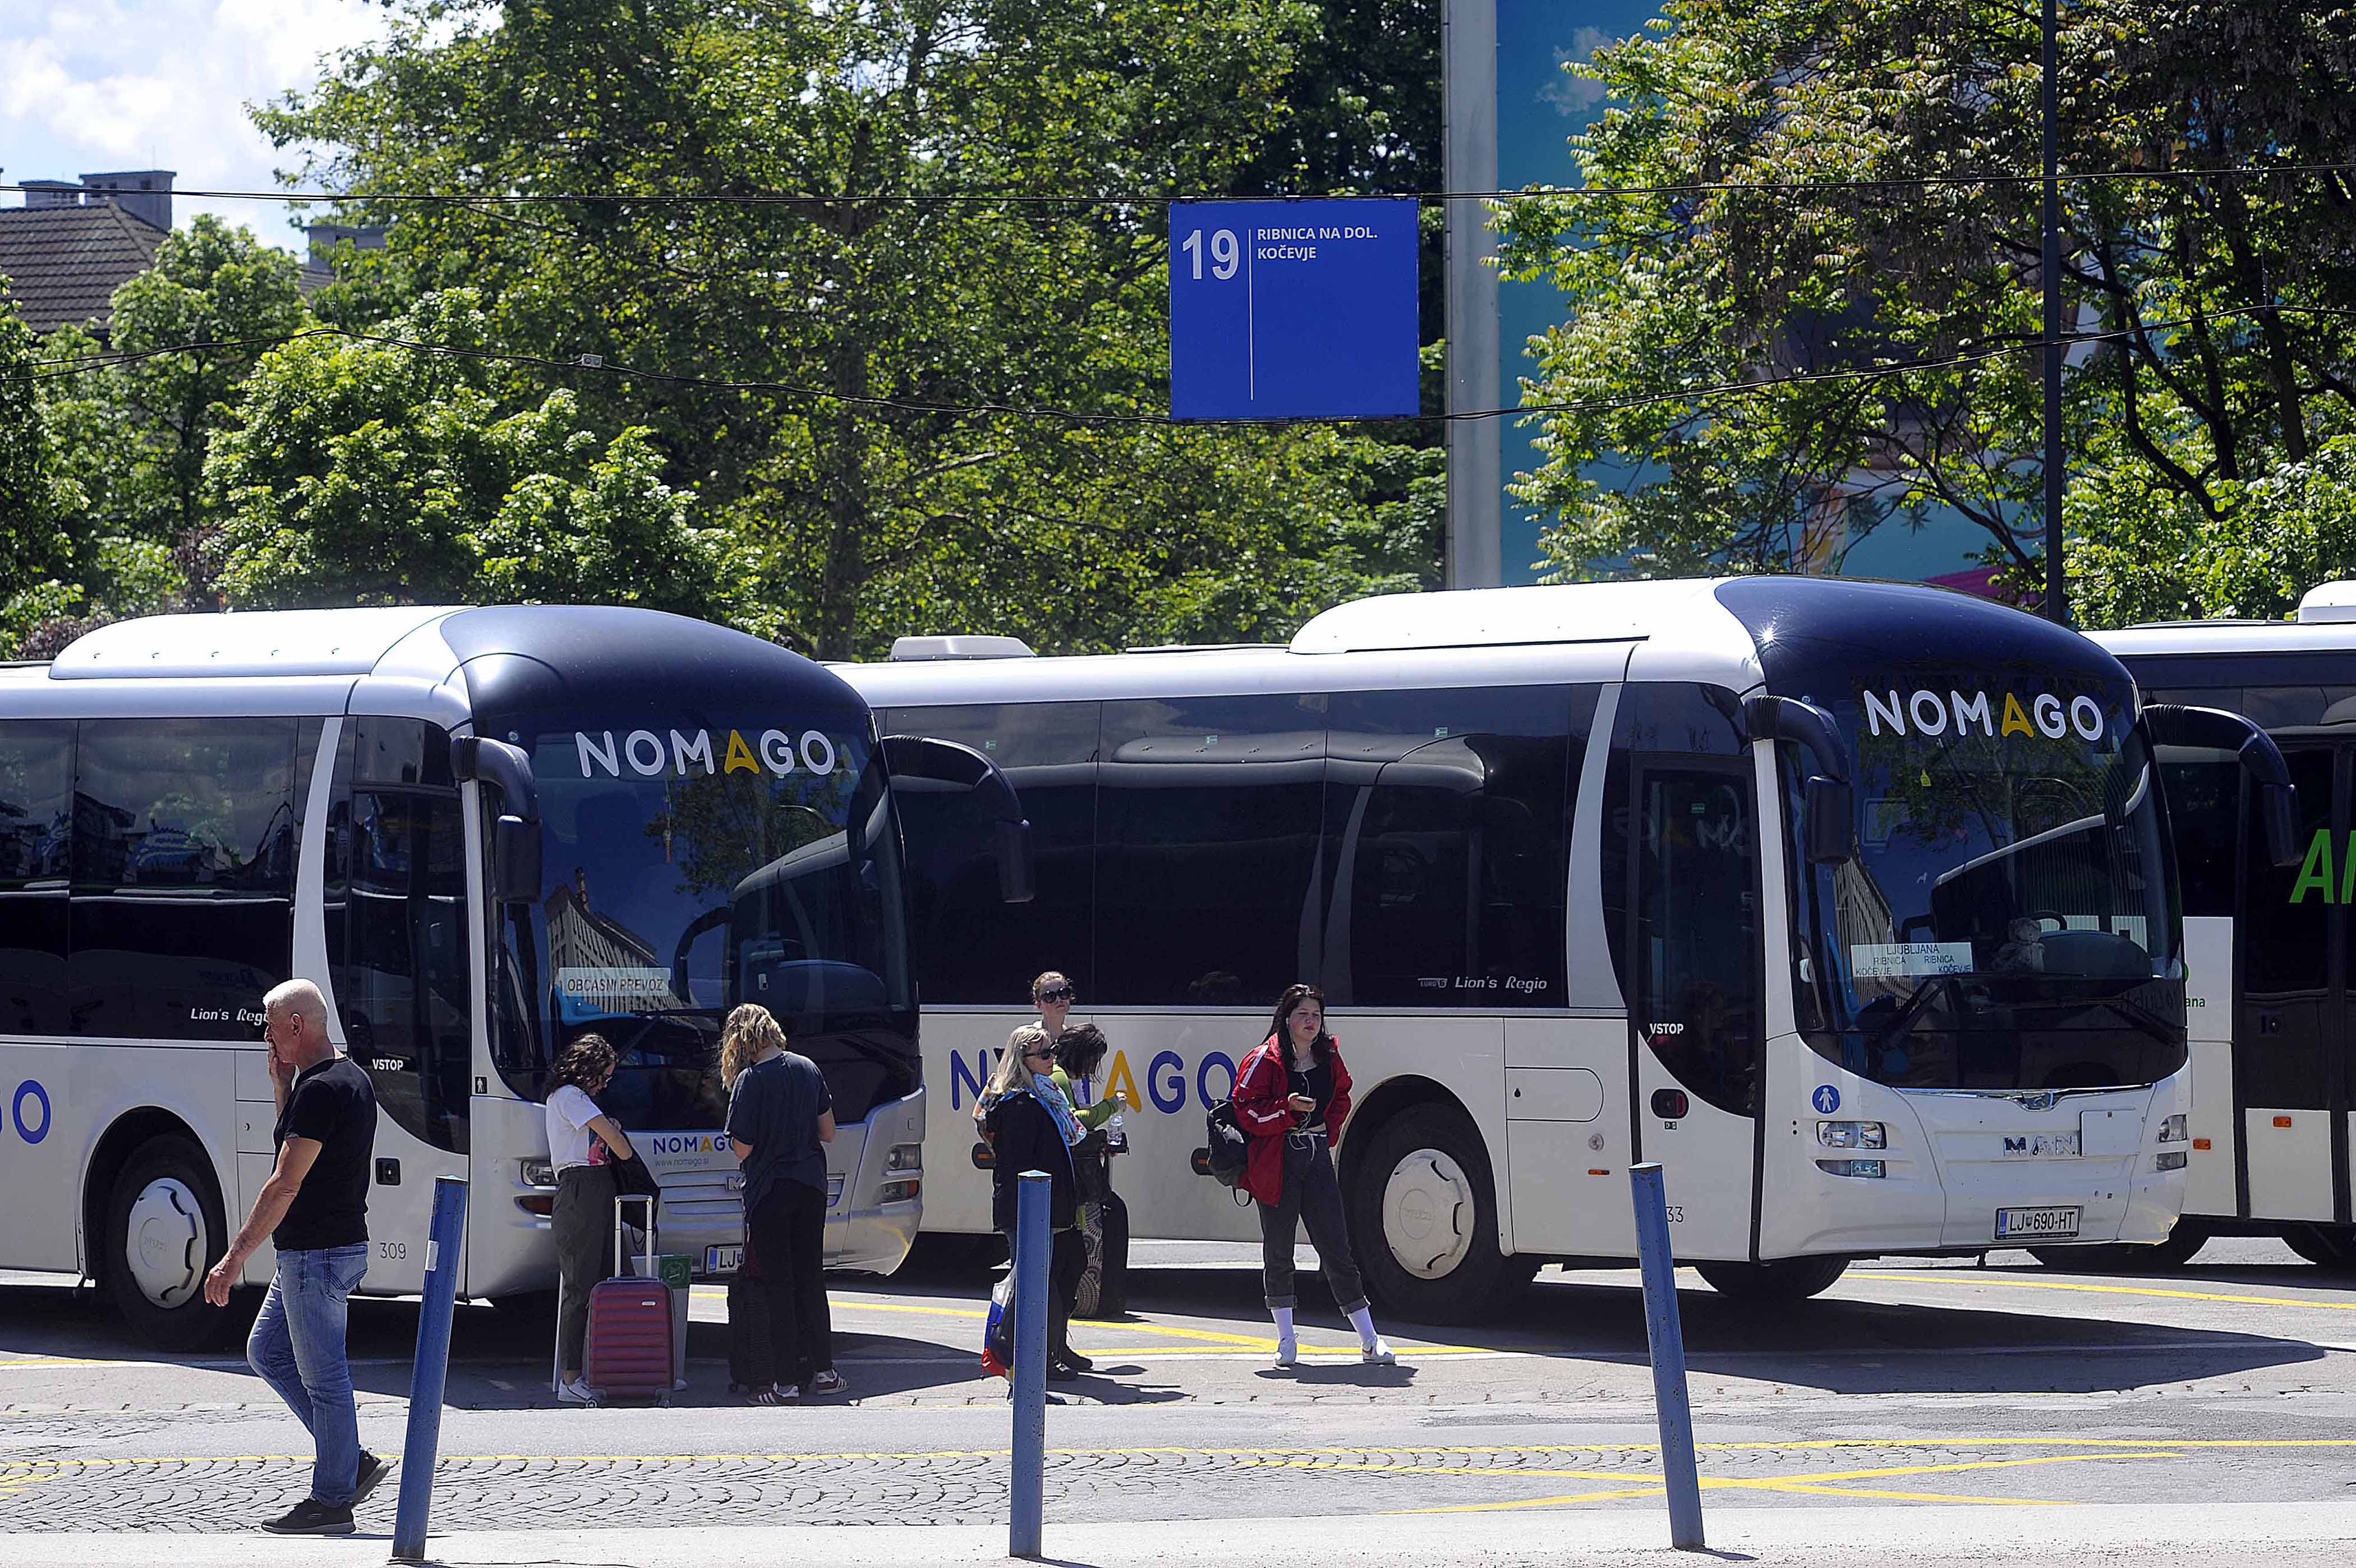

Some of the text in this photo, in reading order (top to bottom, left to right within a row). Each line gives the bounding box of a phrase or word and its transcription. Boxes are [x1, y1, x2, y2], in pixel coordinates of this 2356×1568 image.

[1257, 226, 1378, 240] RIBNICA NA DOL.
[1182, 229, 1239, 280] 19
[1257, 245, 1317, 261] KOČEVJE
[1863, 690, 2104, 741] NOMAGO
[574, 729, 835, 778] NOMAGO
[1886, 944, 1940, 955] LJUBLJANA
[1924, 955, 1955, 964] RIBNICA
[620, 978, 664, 991] PREVOZ
[1455, 976, 1548, 993] Lion's Regio
[191, 1008, 229, 1020] Lion's
[1649, 1023, 1684, 1035] VSTOP
[372, 1059, 403, 1071] VSTOP
[950, 1050, 1237, 1114] NAGO
[2003, 1135, 2079, 1156] MAN
[1666, 1206, 1683, 1222] 33
[379, 1242, 406, 1259] 309
[719, 1250, 736, 1268] LJ
